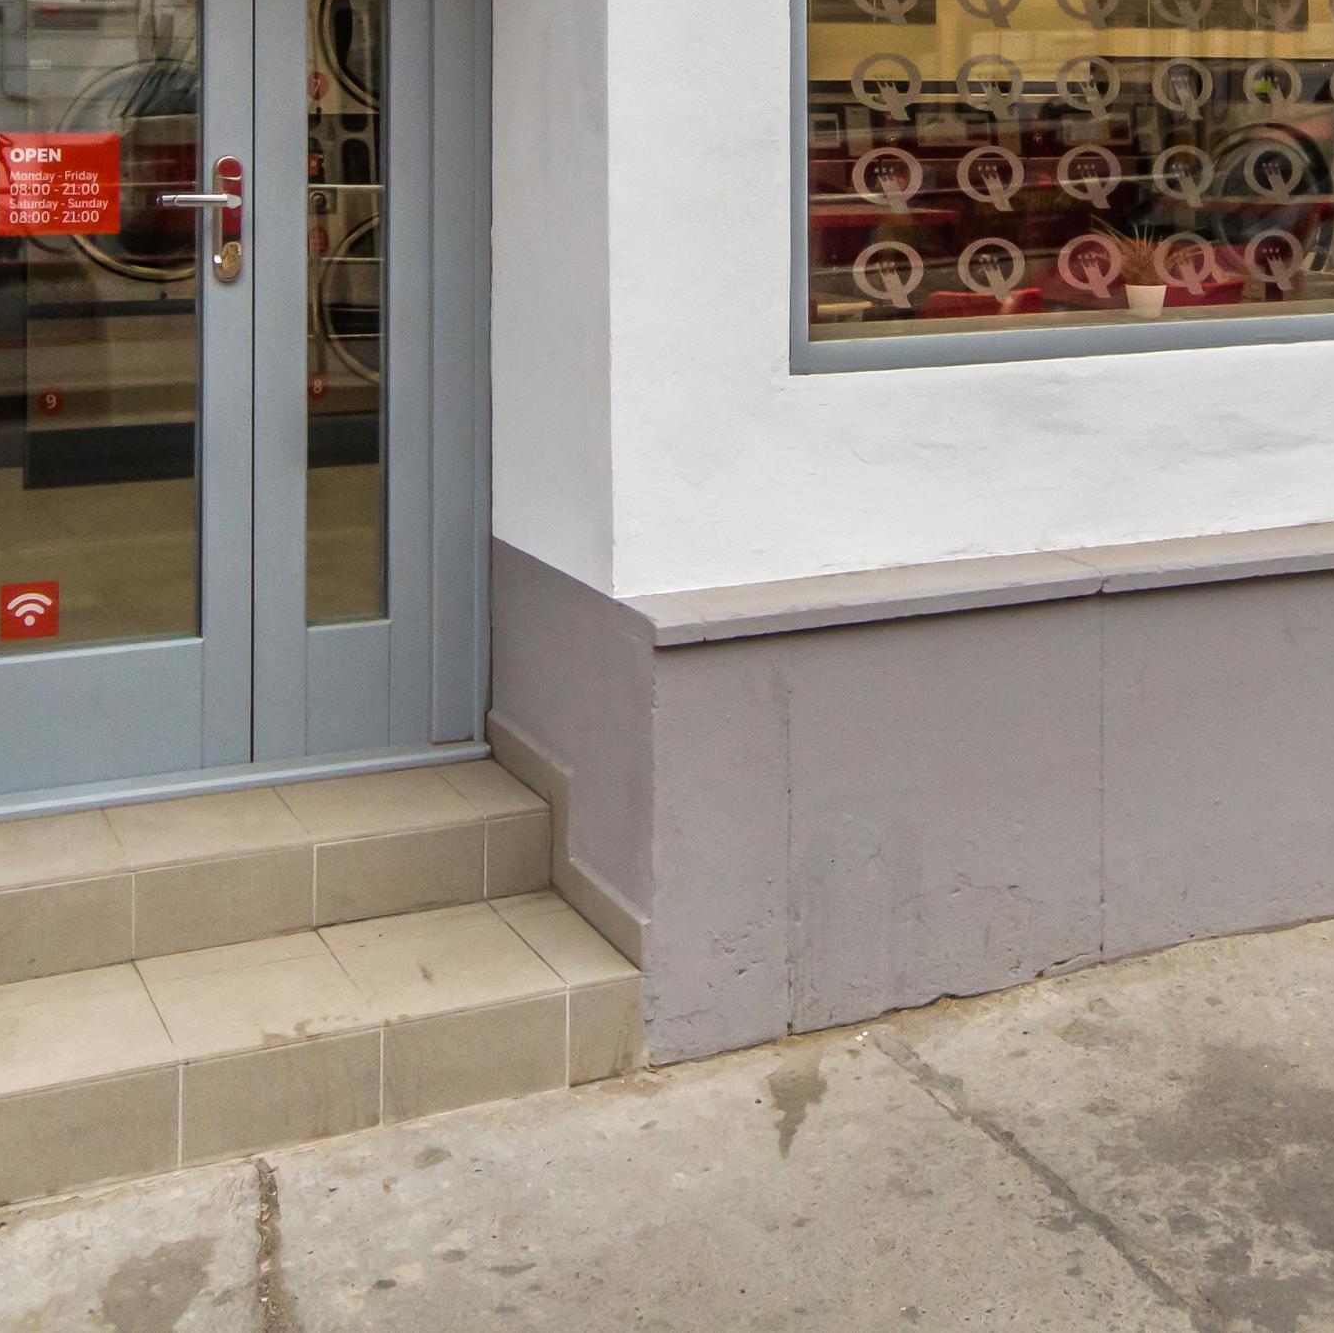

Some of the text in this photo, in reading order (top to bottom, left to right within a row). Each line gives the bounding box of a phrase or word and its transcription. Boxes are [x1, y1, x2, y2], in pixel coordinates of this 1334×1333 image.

[10, 148, 61, 163] OPEN
[10, 171, 55, 183] Monday
[64, 170, 98, 182] Friday
[10, 183, 50, 196] 08:00
[62, 183, 100, 195] 21:00
[9, 198, 59, 210] Saturday
[67, 198, 109, 210] Sunday
[9, 211, 50, 224] 08:00
[62, 210, 100, 223] 21:00
[46, 394, 57, 409] 9
